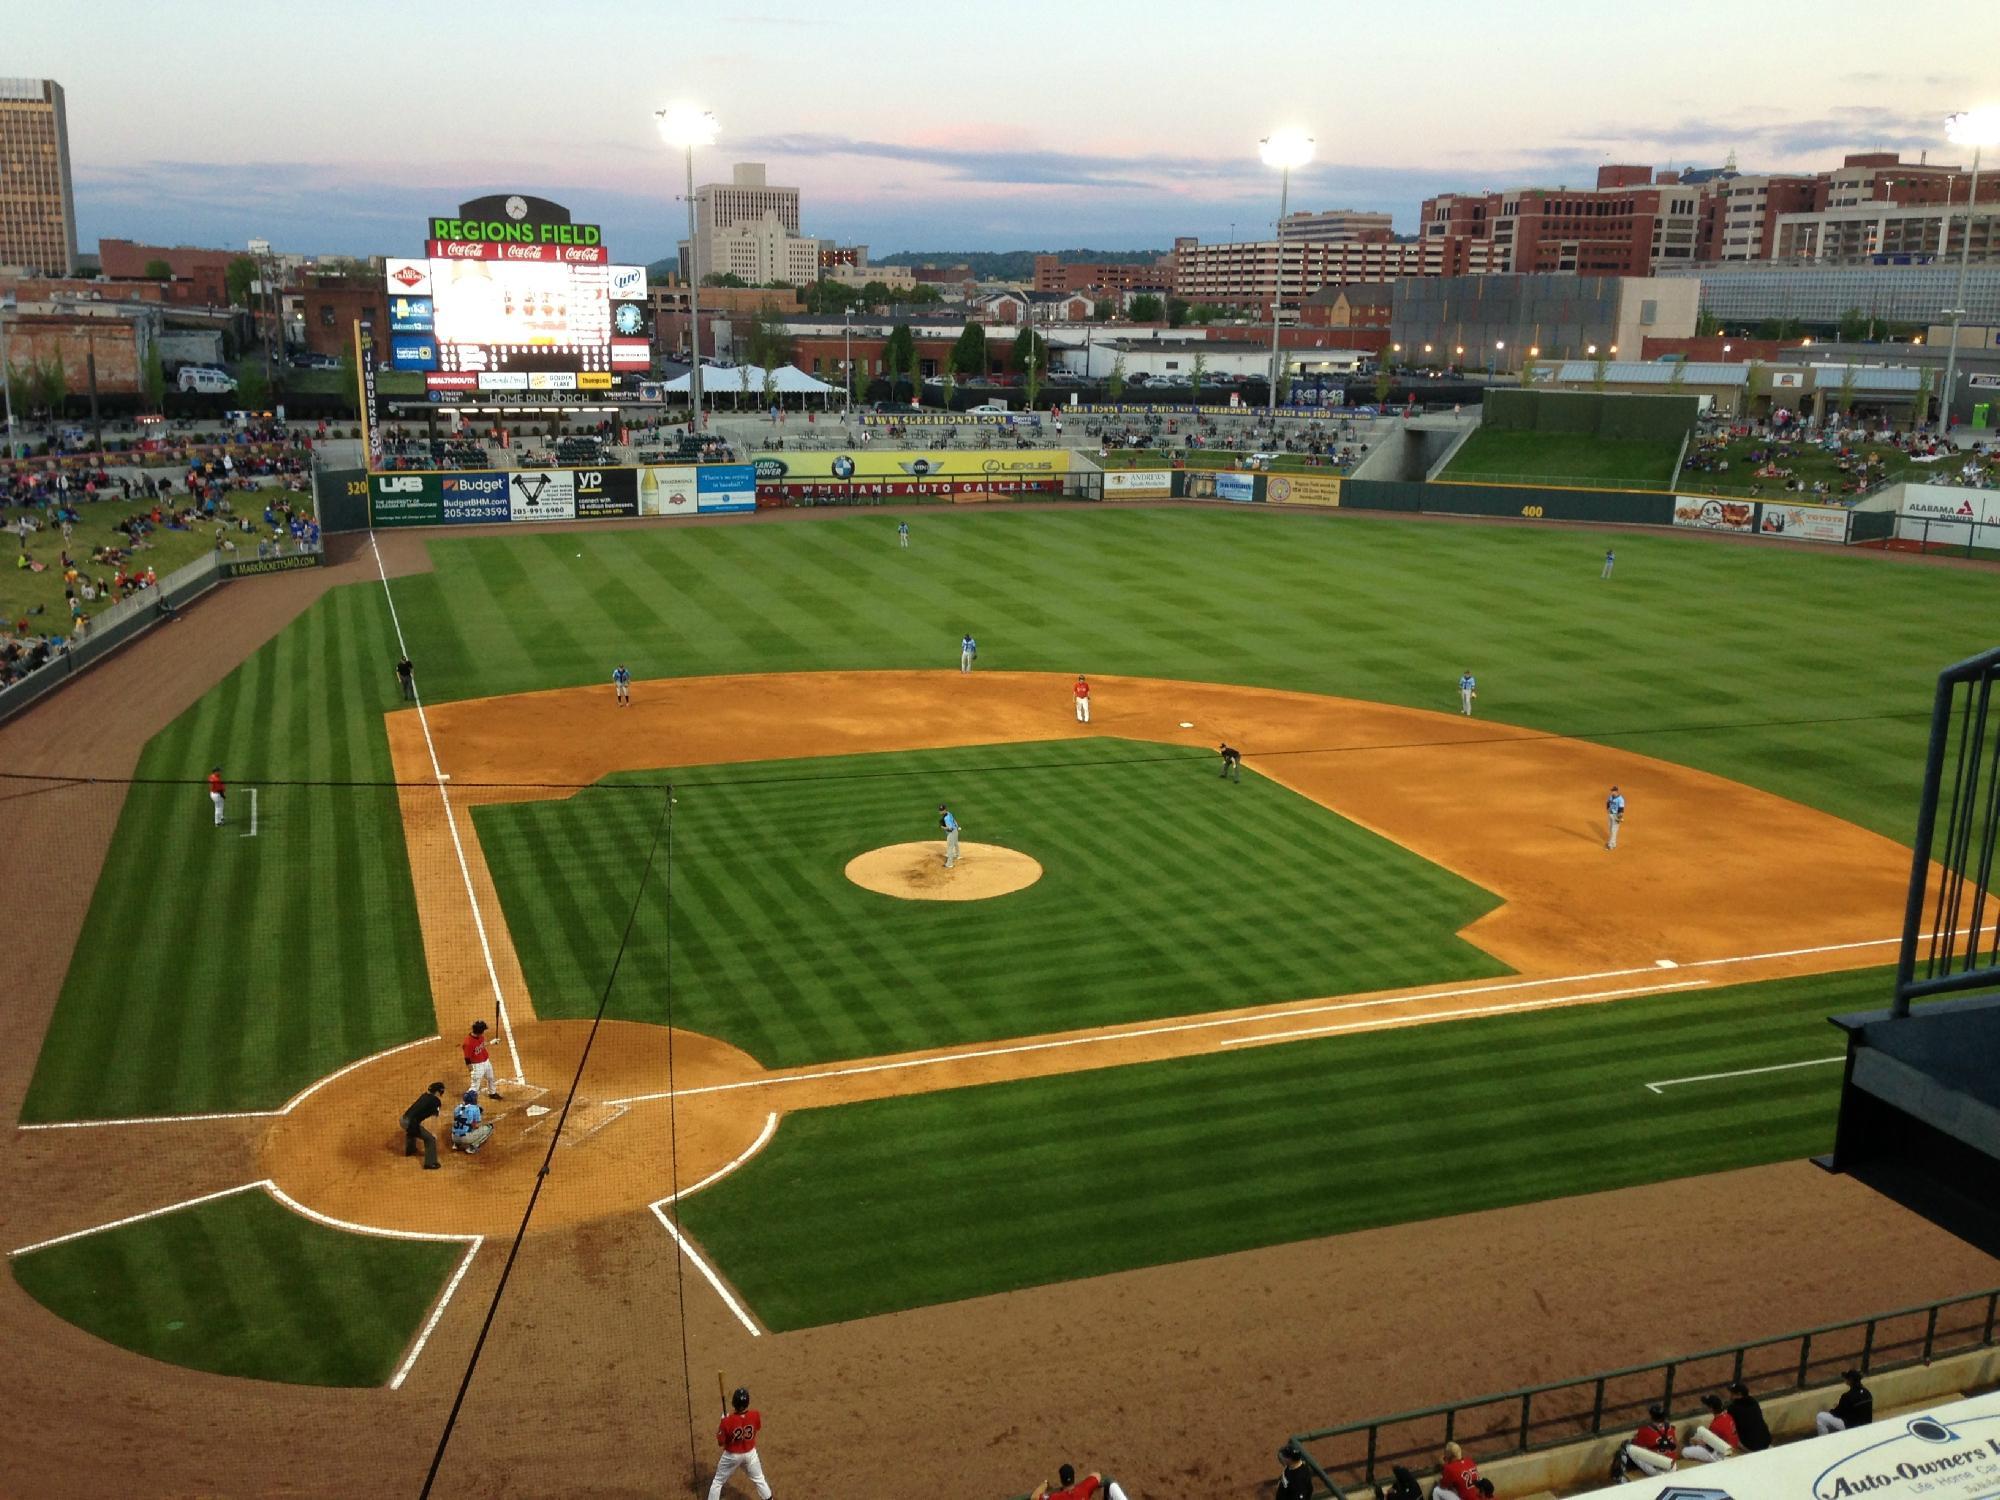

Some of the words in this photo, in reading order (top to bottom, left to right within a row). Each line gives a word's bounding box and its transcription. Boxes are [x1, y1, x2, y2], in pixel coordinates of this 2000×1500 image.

[435, 219, 534, 243] REGIONS
[540, 223, 599, 246] FIELD
[490, 394, 523, 404] HOME
[526, 394, 550, 403] RUN
[755, 461, 775, 469] LAND
[1001, 461, 1052, 470] LEXUS
[756, 468, 781, 476] ROVER
[378, 476, 424, 493] UAB
[578, 471, 602, 488] yp
[347, 481, 368, 496] 320
[459, 479, 504, 493] Budget
[802, 484, 894, 494] WILLIAMS
[906, 484, 951, 494] AUTO
[443, 498, 508, 509] BudgetBHM.com
[1909, 503, 1955, 515] ALABAMA
[443, 507, 508, 518] 205-322-3596
[1521, 505, 1543, 518] 400
[733, 1425, 754, 1441] 23
[1821, 1446, 1987, 1500] Auto-Owners
